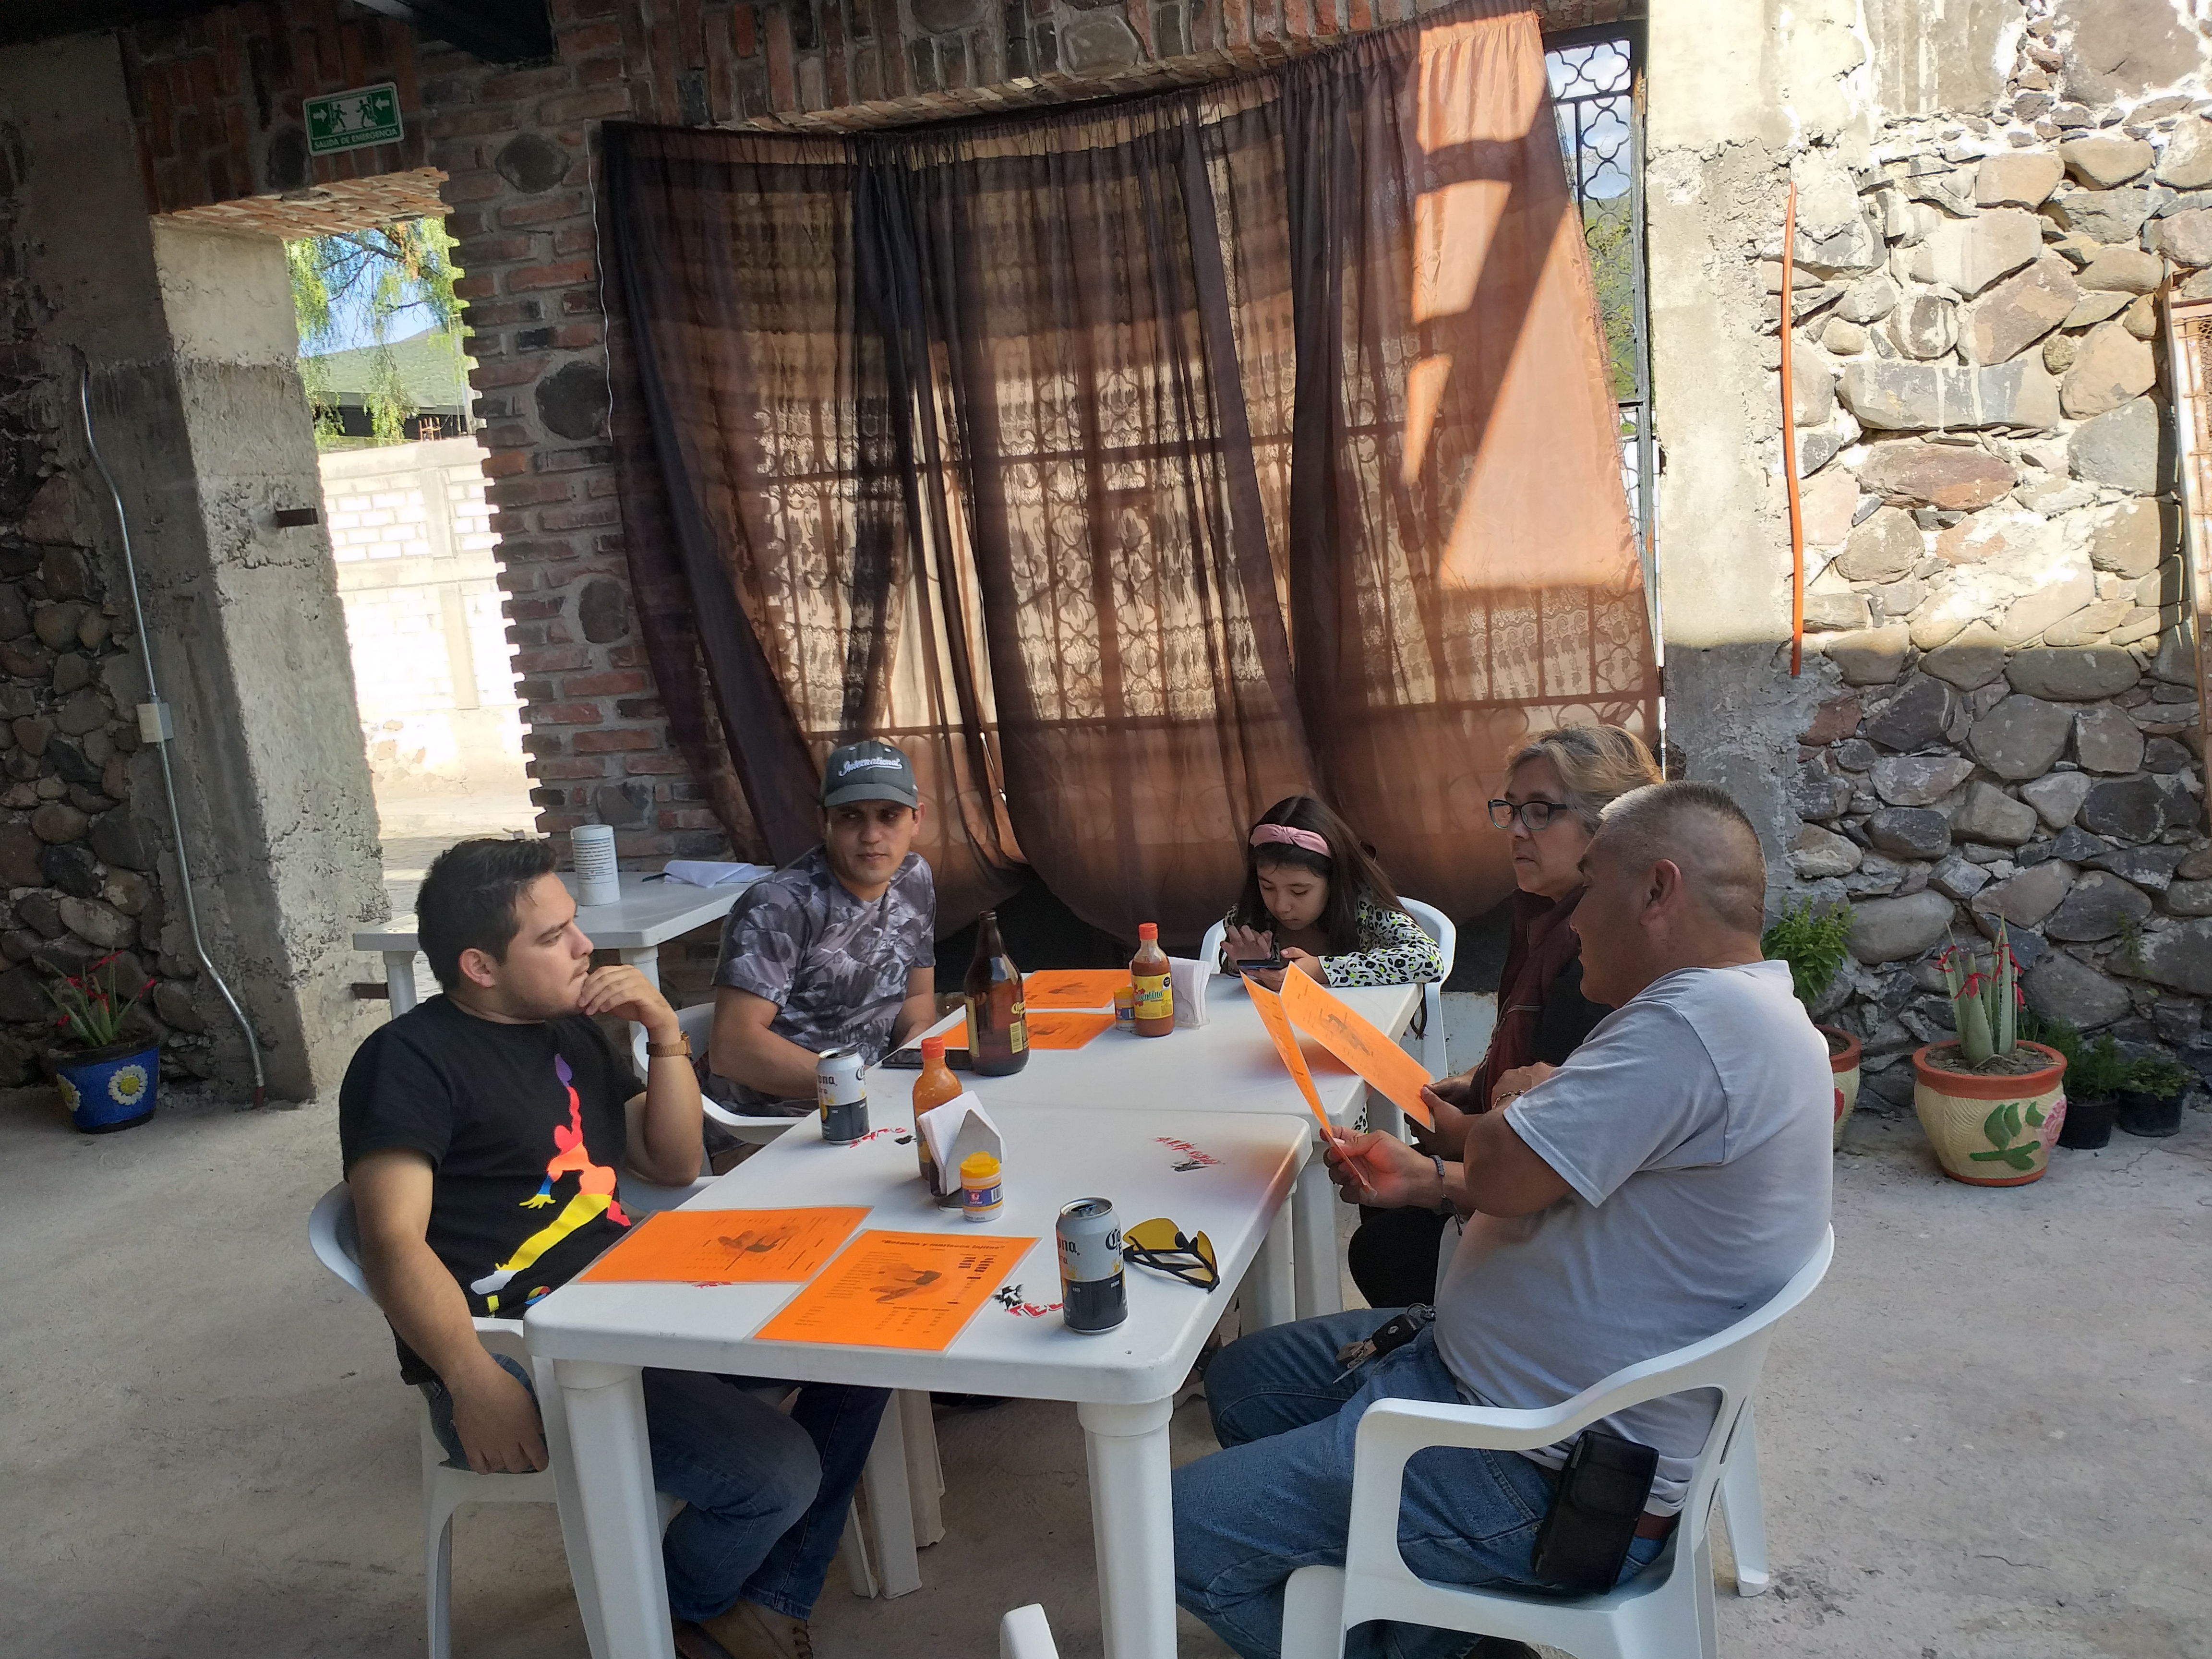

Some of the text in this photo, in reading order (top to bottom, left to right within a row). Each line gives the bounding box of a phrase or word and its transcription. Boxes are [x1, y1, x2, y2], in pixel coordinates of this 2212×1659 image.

[314, 139, 339, 149] SALIDA
[351, 128, 397, 142] EMERGENCIA
[838, 757, 902, 776] International
[1134, 990, 1164, 1002] alentina
